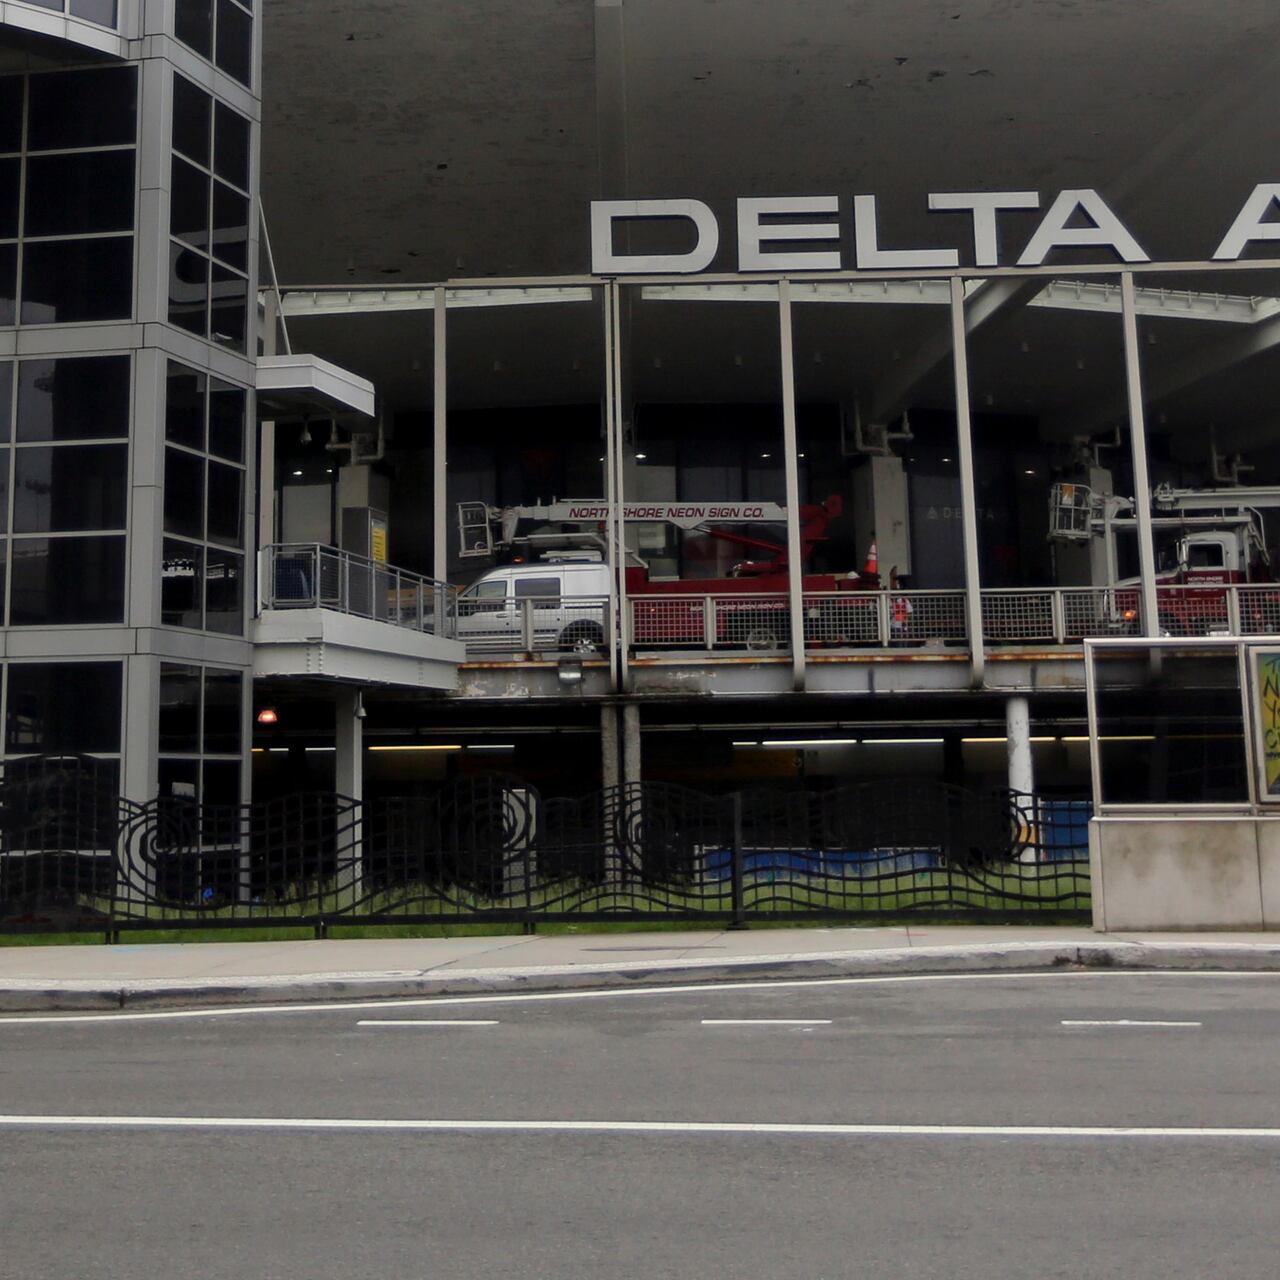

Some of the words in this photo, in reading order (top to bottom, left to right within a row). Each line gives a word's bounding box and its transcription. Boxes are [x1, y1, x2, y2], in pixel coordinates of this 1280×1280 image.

[590, 188, 1151, 275] DELTA
[666, 507, 706, 518] NEON
[708, 507, 740, 518] SIGN
[742, 507, 765, 518] CO.
[943, 506, 994, 520] DETA
